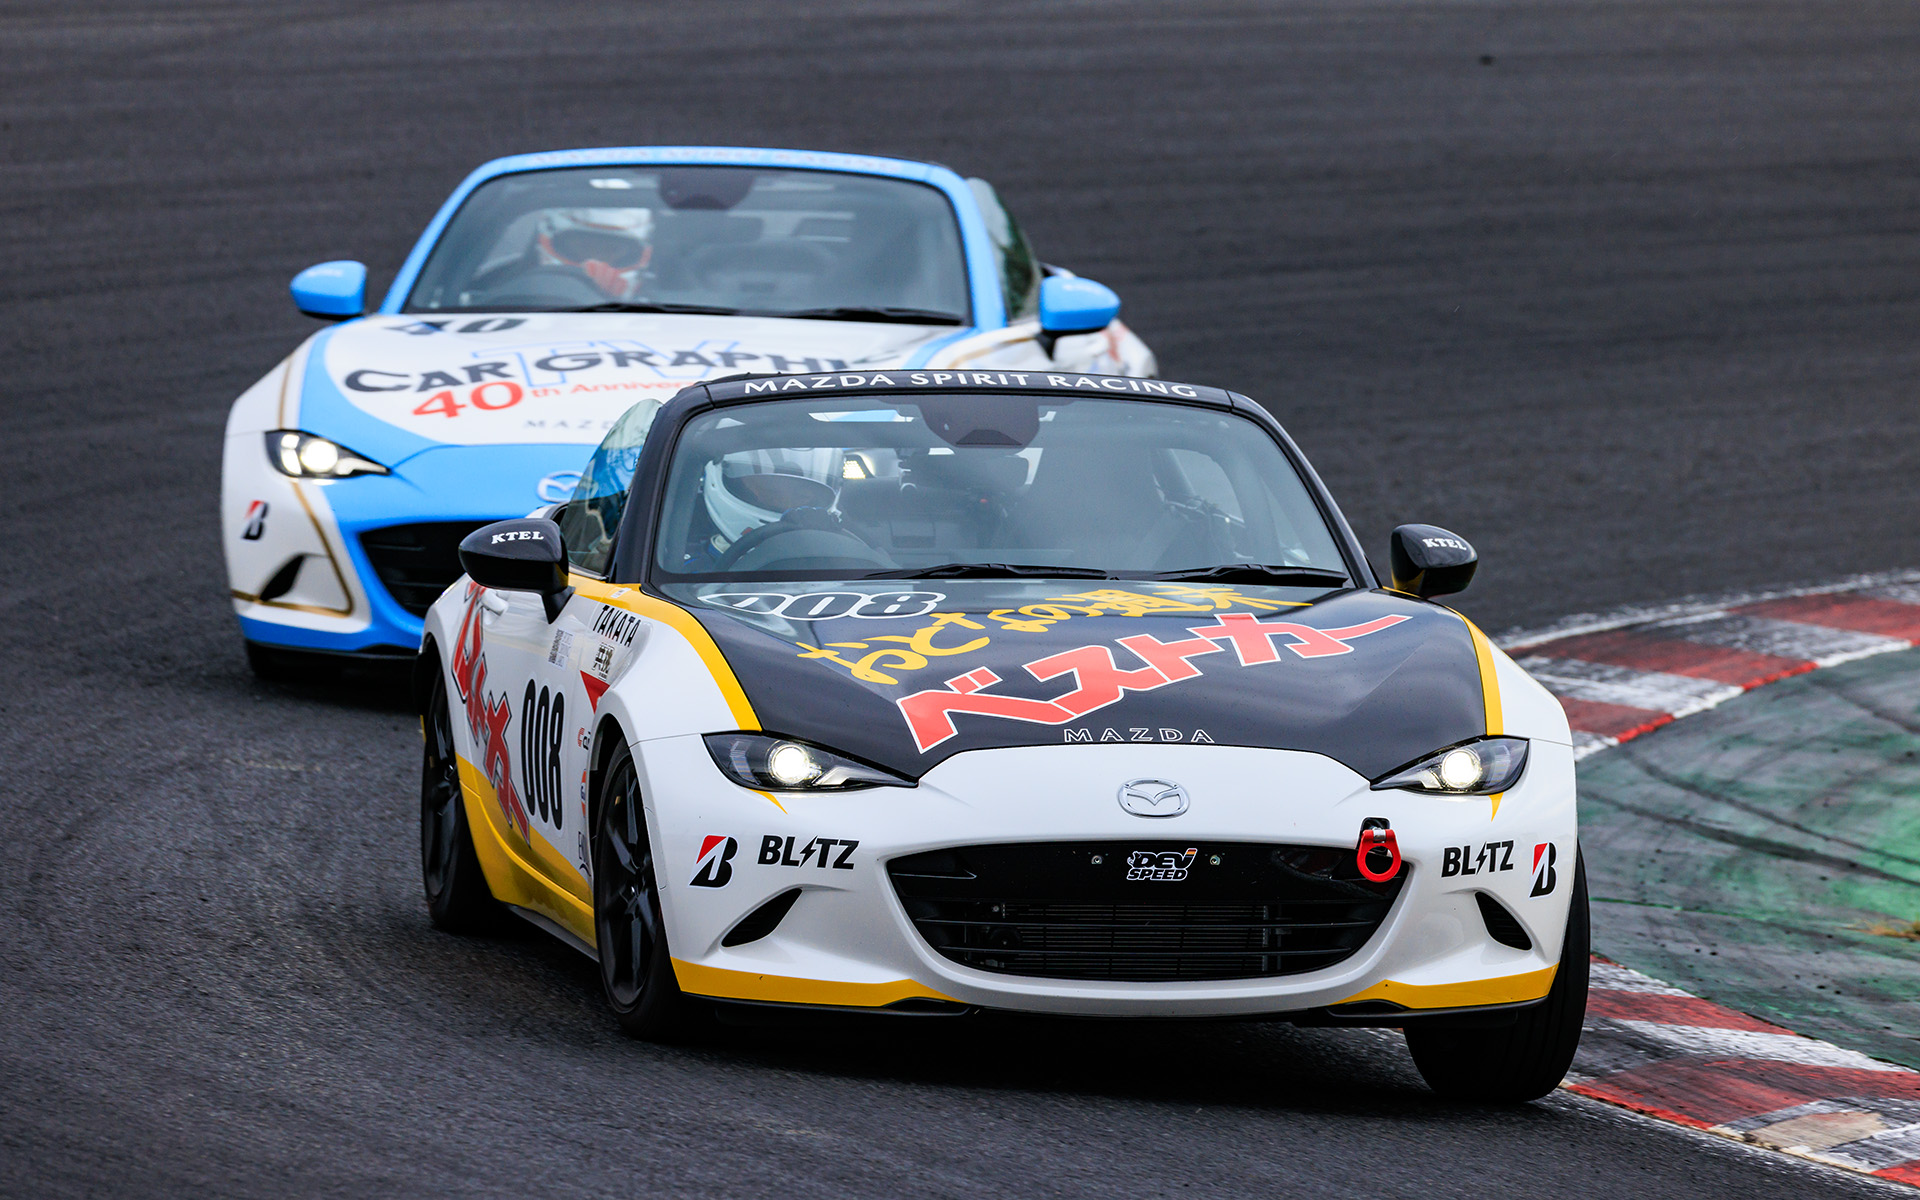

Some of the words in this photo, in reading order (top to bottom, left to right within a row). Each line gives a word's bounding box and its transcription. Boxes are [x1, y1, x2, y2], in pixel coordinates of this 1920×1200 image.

[345, 362, 516, 392] CAR
[534, 350, 849, 381] GRAPHI
[571, 380, 693, 394] Anniver
[744, 374, 896, 394] MAZDA
[910, 373, 1000, 386] SPIRIT
[1047, 375, 1198, 397] RACING
[491, 531, 544, 544] KTEL
[697, 592, 946, 621] 008
[592, 604, 641, 647] TAKATA
[895, 612, 1413, 753] ベストカー
[1063, 727, 1215, 743] MAZDA
[521, 679, 564, 830] 008
[757, 834, 860, 870] BLITZ
[1441, 839, 1514, 877] BLITZ
[1126, 867, 1188, 881] SPEED
